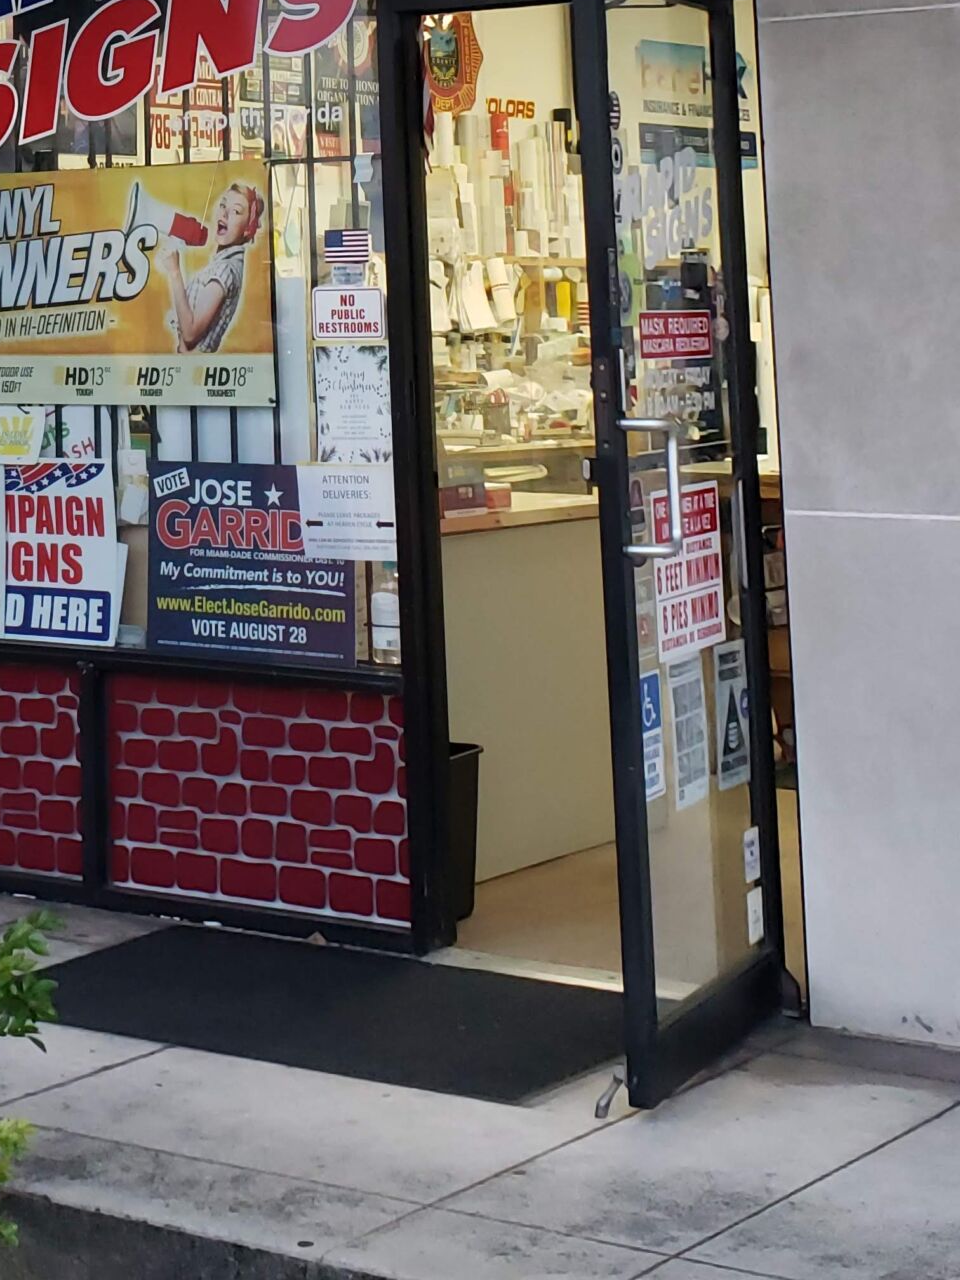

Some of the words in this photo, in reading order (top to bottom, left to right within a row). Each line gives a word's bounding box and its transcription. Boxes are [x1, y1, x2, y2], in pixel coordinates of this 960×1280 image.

[321, 77, 337, 89] THE
[356, 80, 380, 93] HONO
[486, 98, 535, 119] OLORS
[626, 147, 696, 220] RAPID
[645, 187, 713, 269] SIGNS
[340, 294, 355, 307] NO
[4, 318, 17, 337] IN
[19, 310, 107, 337] HI-DEFINITION
[331, 308, 365, 320] PUBLIC
[319, 321, 379, 333] RESTROOMS
[640, 318, 665, 335] MASK
[668, 317, 708, 334] REQUIRED
[20, 367, 34, 377] USE
[76, 388, 94, 397] TOUGH
[140, 388, 163, 397] TOUGHER
[207, 389, 236, 397] TOUGHEST
[156, 472, 187, 493] VOTE
[322, 475, 369, 485] ATTENTION
[188, 479, 252, 506] JOSE
[322, 490, 371, 499] DELIVERIES:
[6, 494, 105, 537] PAIGN
[156, 499, 304, 551] GARRID
[6, 541, 83, 584] GNS
[206, 550, 251, 559] MIAMI-DADE
[254, 551, 313, 563] COMMISSIONER
[160, 561, 180, 579] My
[184, 563, 268, 583] Commitment
[272, 568, 283, 583] is
[287, 569, 301, 584] to
[306, 570, 345, 587] YOU!
[657, 567, 662, 595] 6
[665, 562, 683, 593] FEET
[686, 553, 720, 586] MINIMUM
[31, 595, 103, 633] HERE
[157, 596, 346, 623] www.ElectJoseGarrido.com
[663, 605, 668, 634] 6
[671, 600, 688, 632] PIES
[691, 591, 718, 625] MINIMO
[192, 619, 226, 638] VOTE
[230, 623, 286, 642] AUGUST
[289, 627, 307, 644] 28
